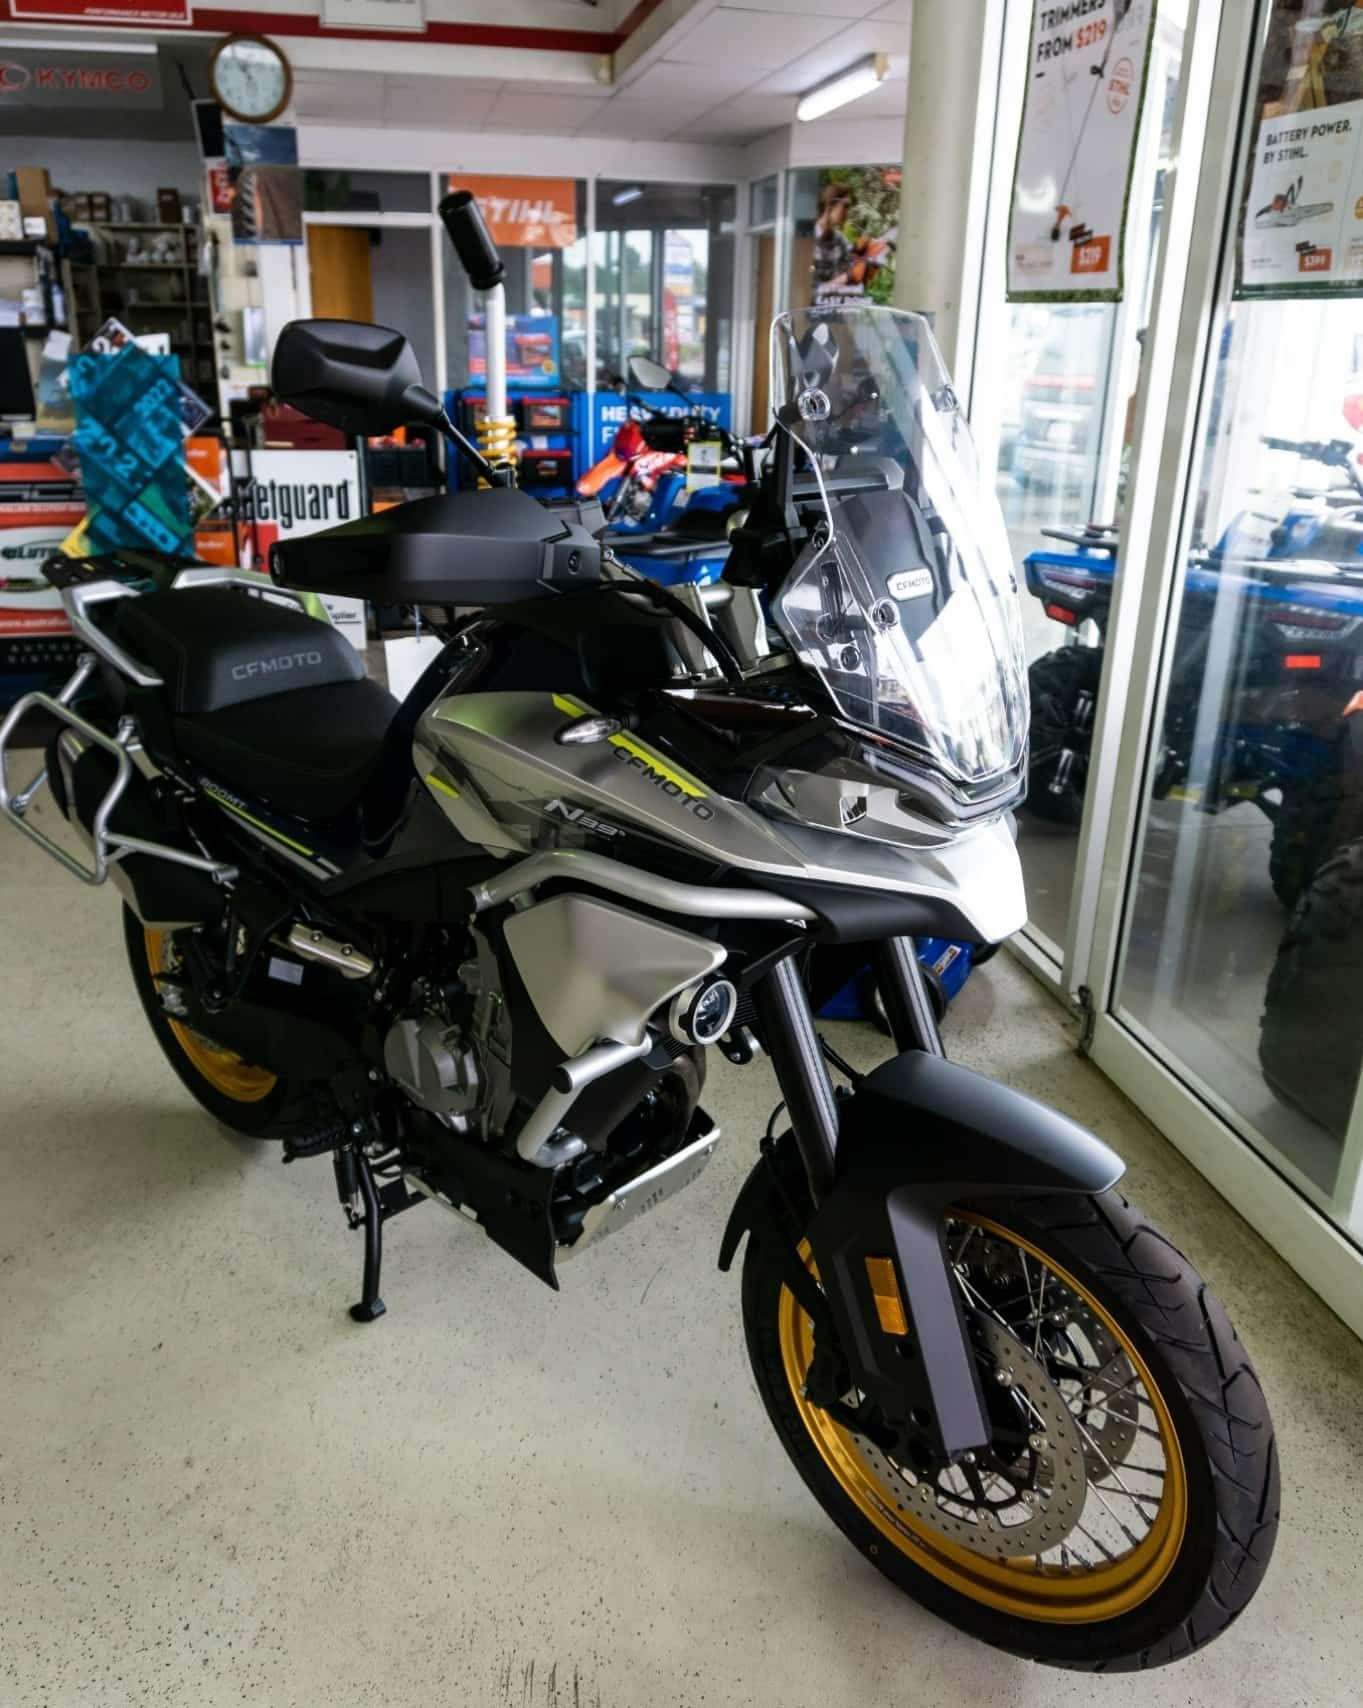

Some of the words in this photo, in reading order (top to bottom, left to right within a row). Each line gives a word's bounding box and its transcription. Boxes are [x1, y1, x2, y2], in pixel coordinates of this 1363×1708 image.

[1041, 0, 1105, 31] TRIMMERS
[1036, 35, 1073, 63] FROM
[36, 67, 150, 93] KYMCO
[1265, 127, 1309, 147] BATTERY
[1311, 119, 1352, 138] POWER.
[1263, 151, 1276, 165] BY
[1277, 146, 1309, 162] STIHL.
[896, 575, 931, 591] CFMOTO
[231, 651, 322, 681] CFMOTO
[613, 745, 714, 821] CFMOTO
